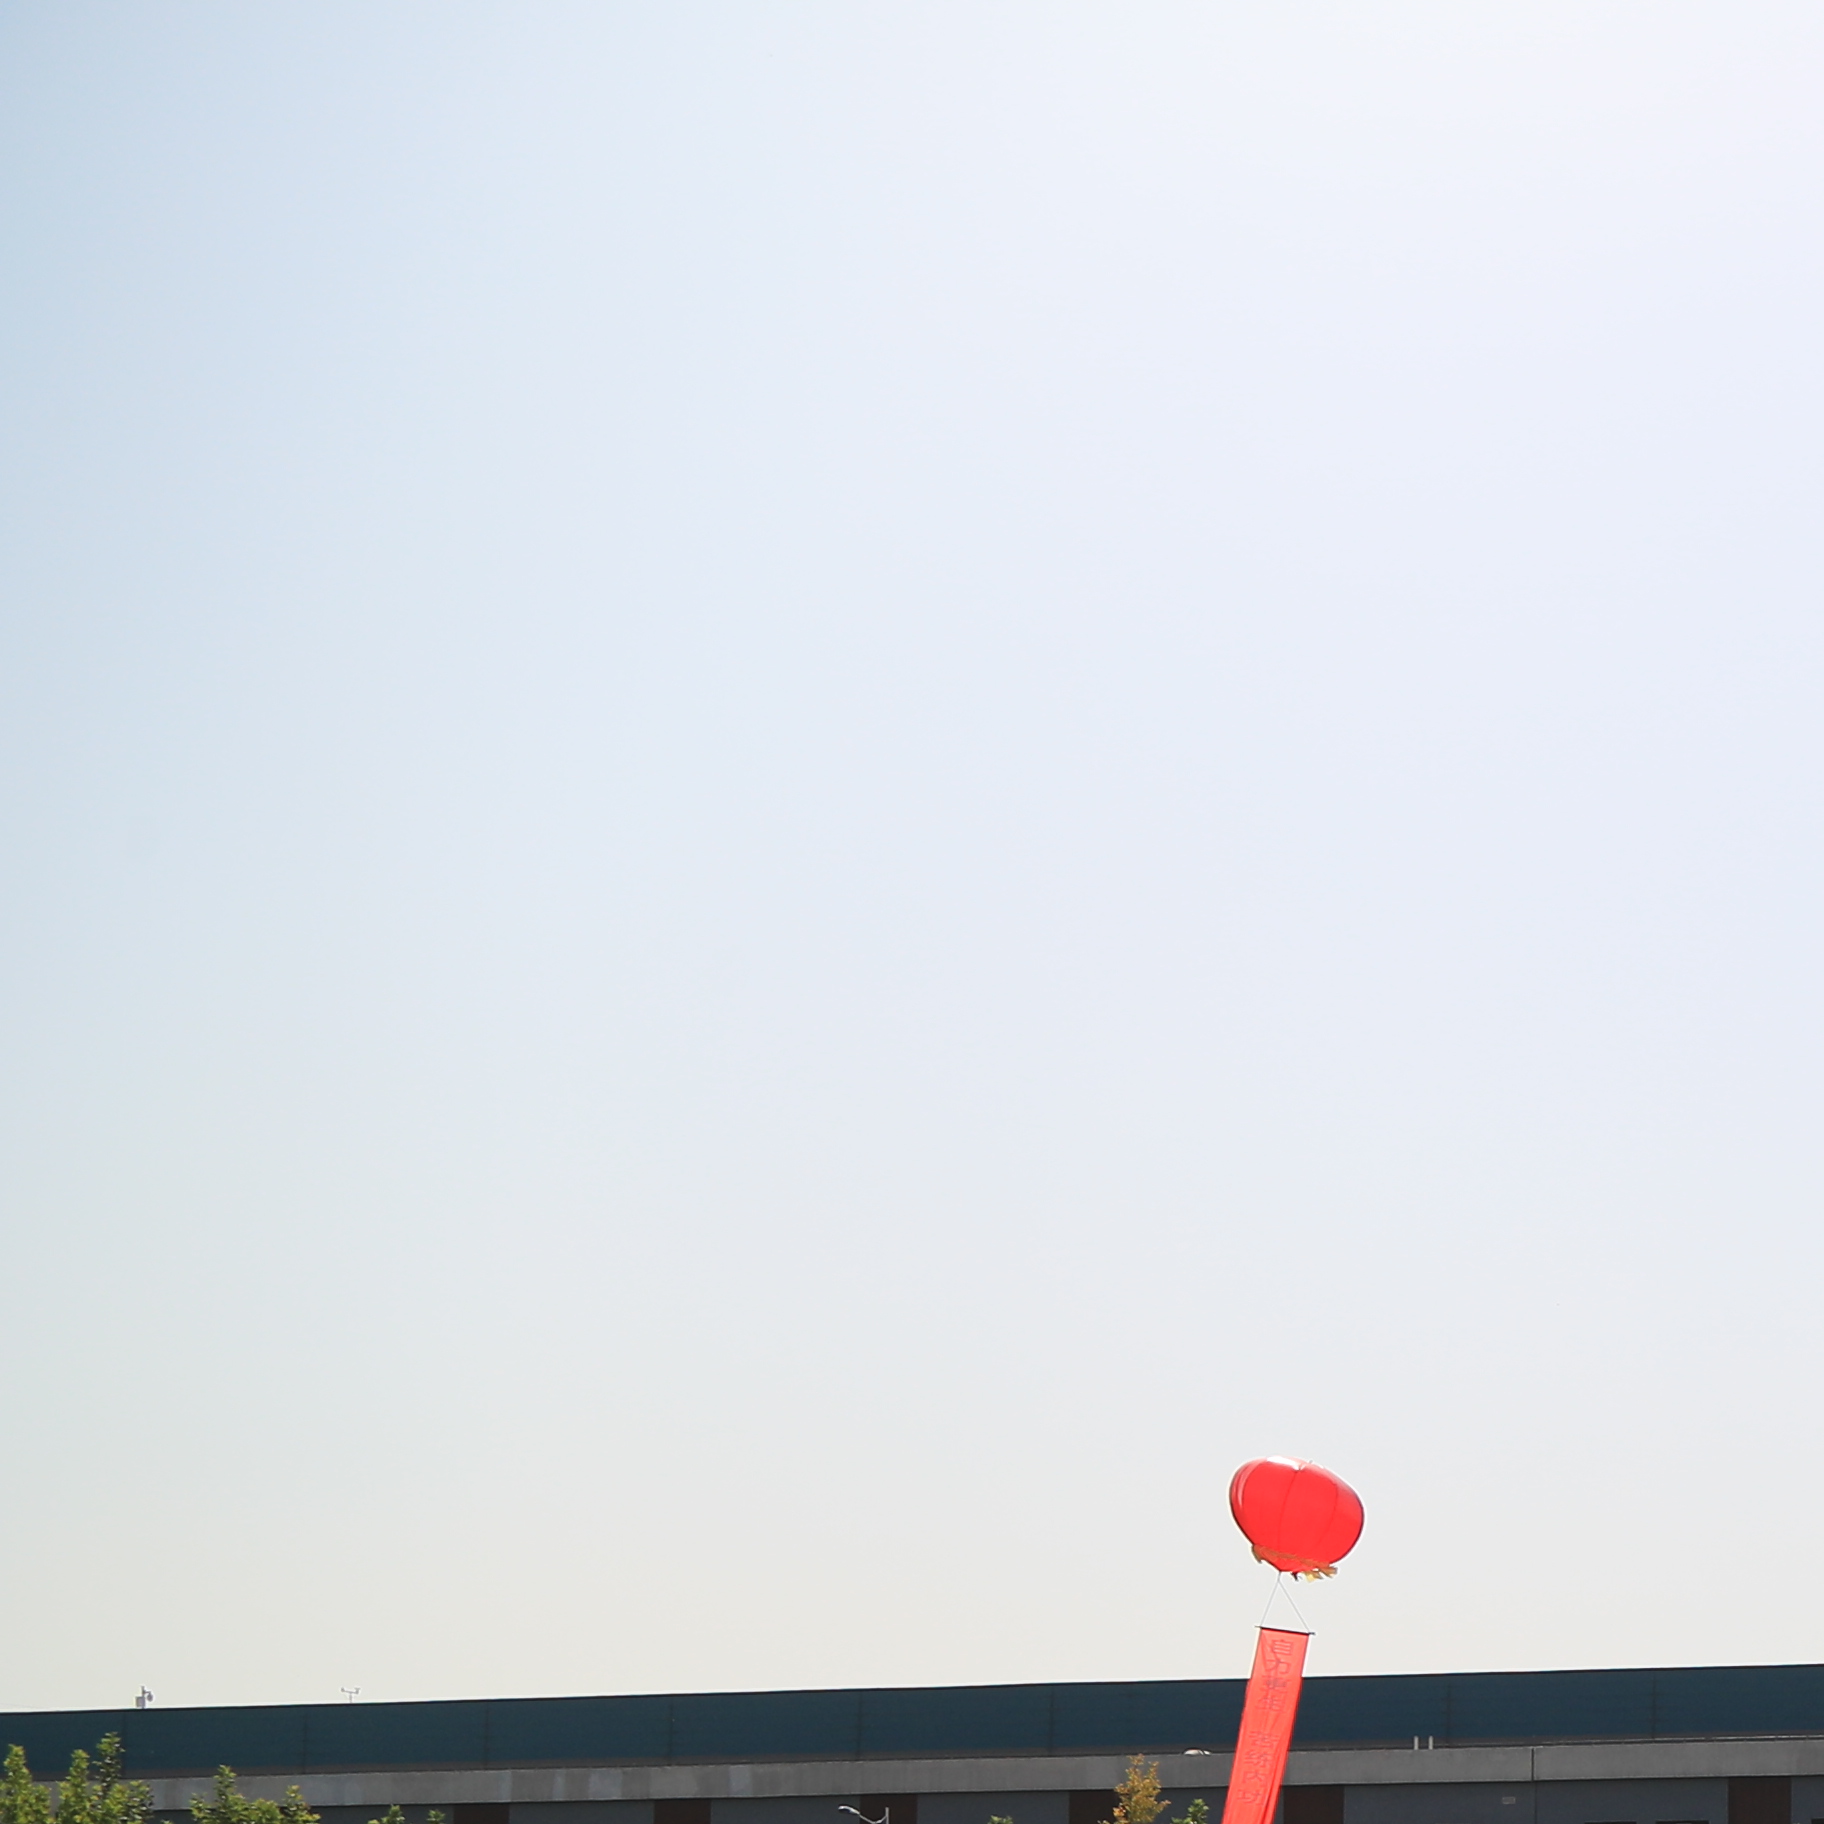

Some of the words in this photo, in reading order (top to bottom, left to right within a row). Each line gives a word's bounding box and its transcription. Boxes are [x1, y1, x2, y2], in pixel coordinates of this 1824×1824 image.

[1255, 1638, 1294, 1711] 自力更生
[1237, 1730, 1280, 1806] 苦练内功
